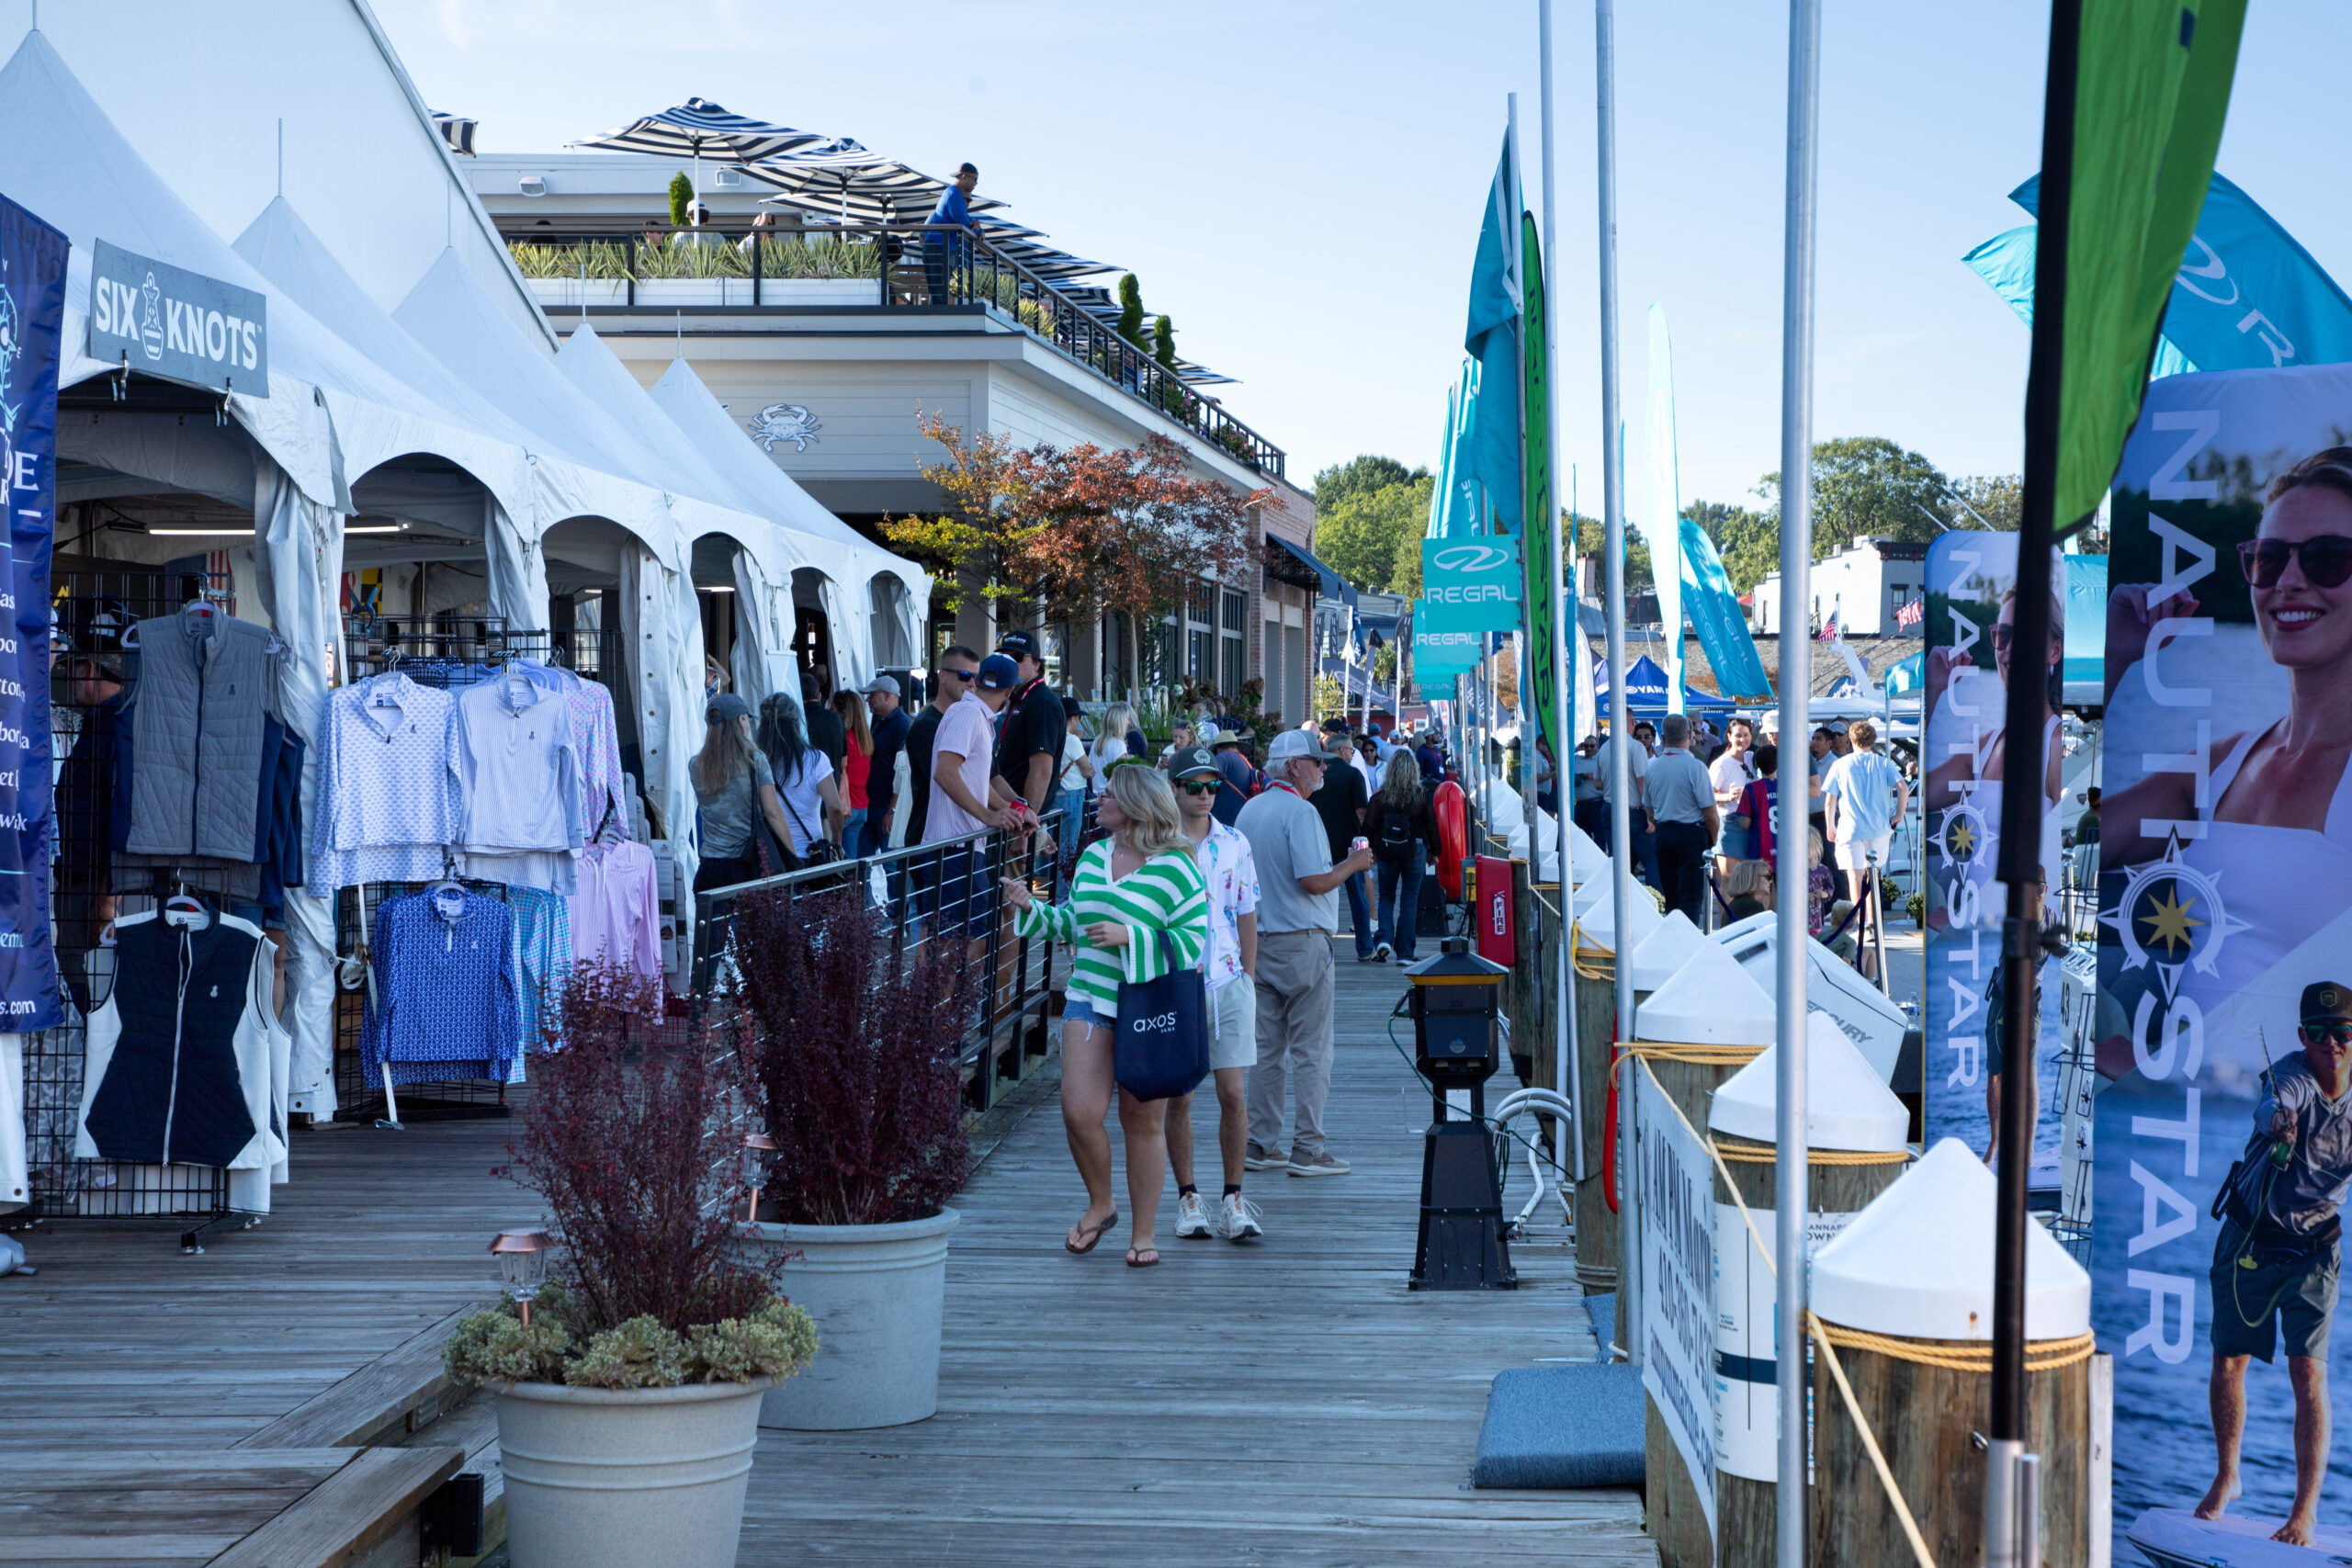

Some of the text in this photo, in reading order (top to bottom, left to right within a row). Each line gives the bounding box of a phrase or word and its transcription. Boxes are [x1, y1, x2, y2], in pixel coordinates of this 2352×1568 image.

[96, 276, 257, 370] SIX KNOTS
[1427, 584, 1519, 604] REGAL
[1416, 632, 1481, 647] REGAL
[1421, 682, 1455, 691] REGAL
[1767, 792, 1780, 800] PED
[1496, 902, 1504, 932] FIRE
[1133, 1012, 1176, 1032] axos
